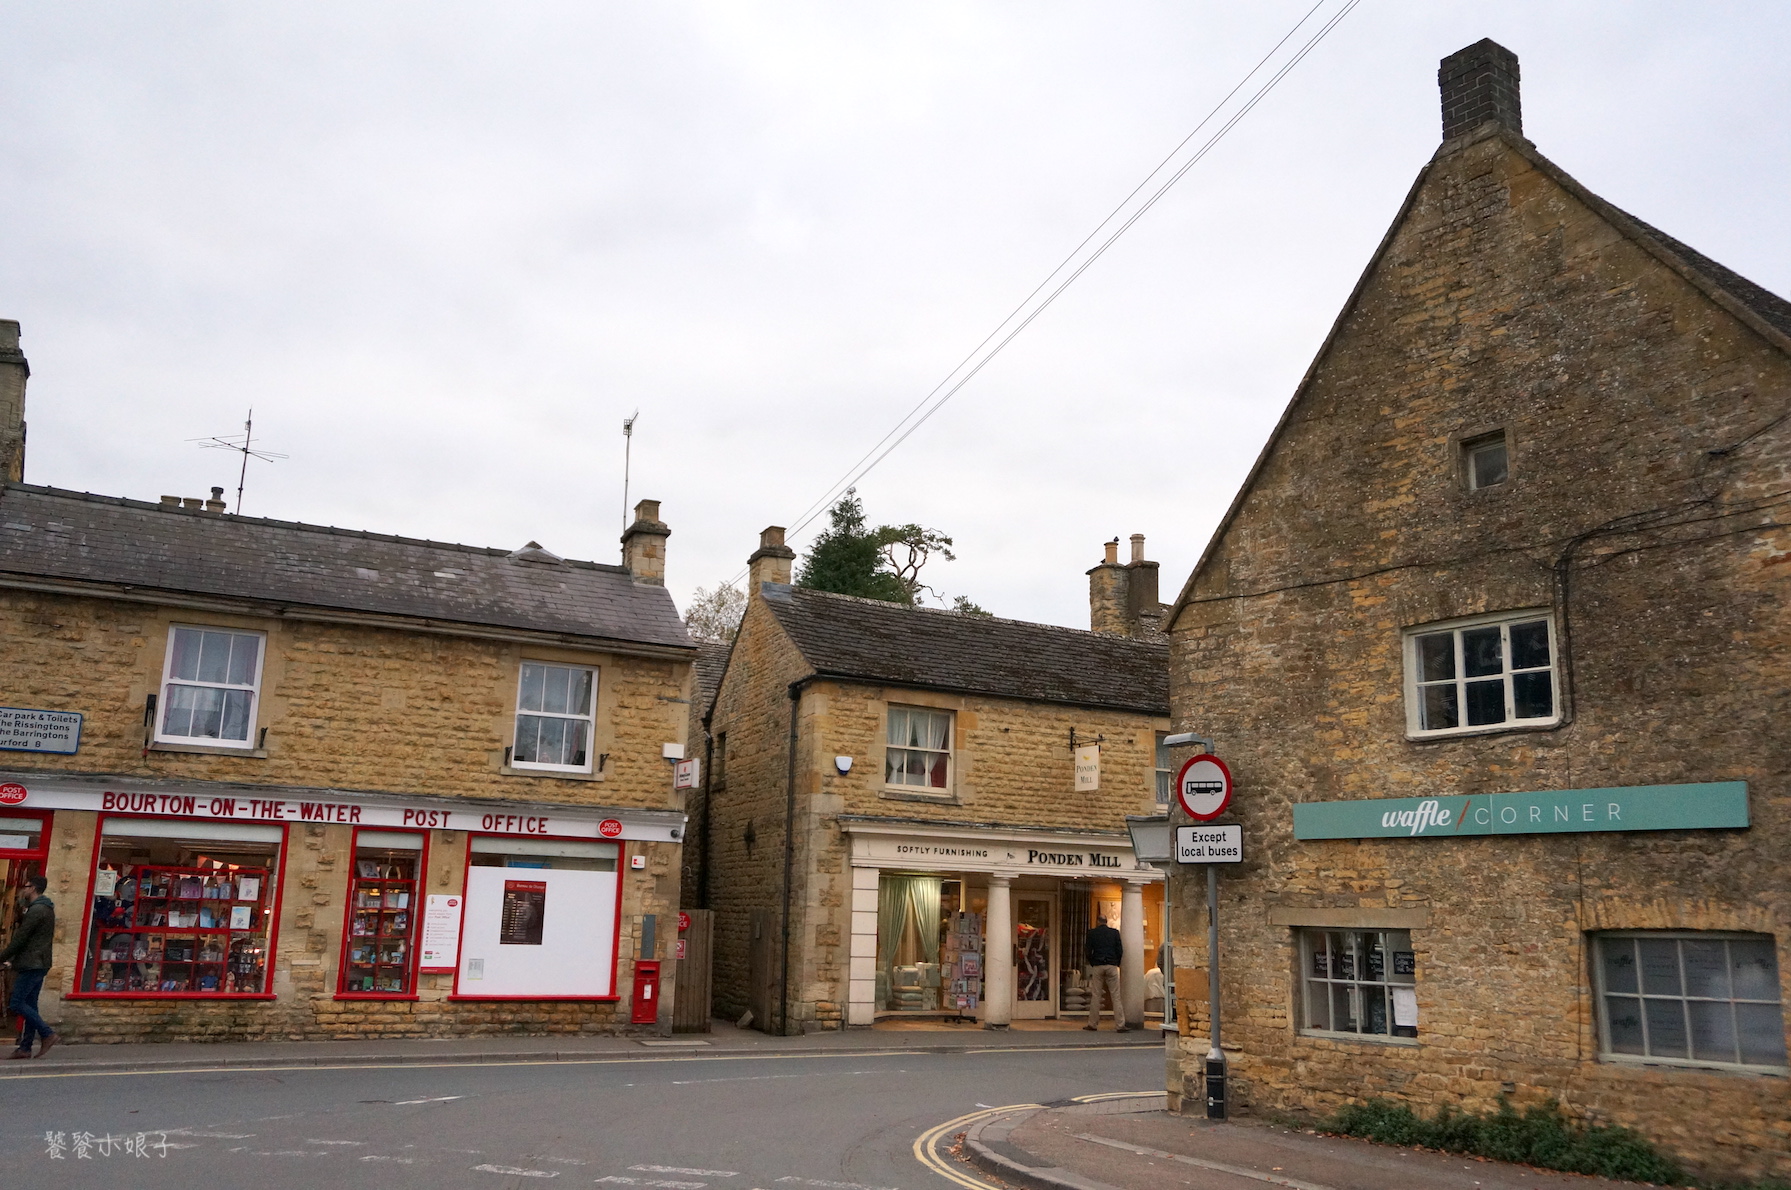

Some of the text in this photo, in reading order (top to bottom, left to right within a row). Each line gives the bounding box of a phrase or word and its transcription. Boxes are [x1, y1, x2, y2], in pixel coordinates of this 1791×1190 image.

[15, 713, 36, 721] park
[47, 714, 78, 724] Toilets
[15, 720, 70, 731] Rissingtons
[13, 729, 69, 740] Barringtons
[0, 739, 28, 747] urford
[1076, 765, 1098, 774] PONDEN
[1080, 776, 1093, 784] MILL
[102, 791, 549, 834] BOURTON-ON-THE-WATER POST OFFICE
[1381, 800, 1621, 836] waffle CORNER
[1192, 831, 1227, 844] Except
[897, 845, 988, 857] SOFTLY FURNISHING
[1181, 845, 1238, 857] local buses
[1027, 849, 1121, 868] PONDEN MILL
